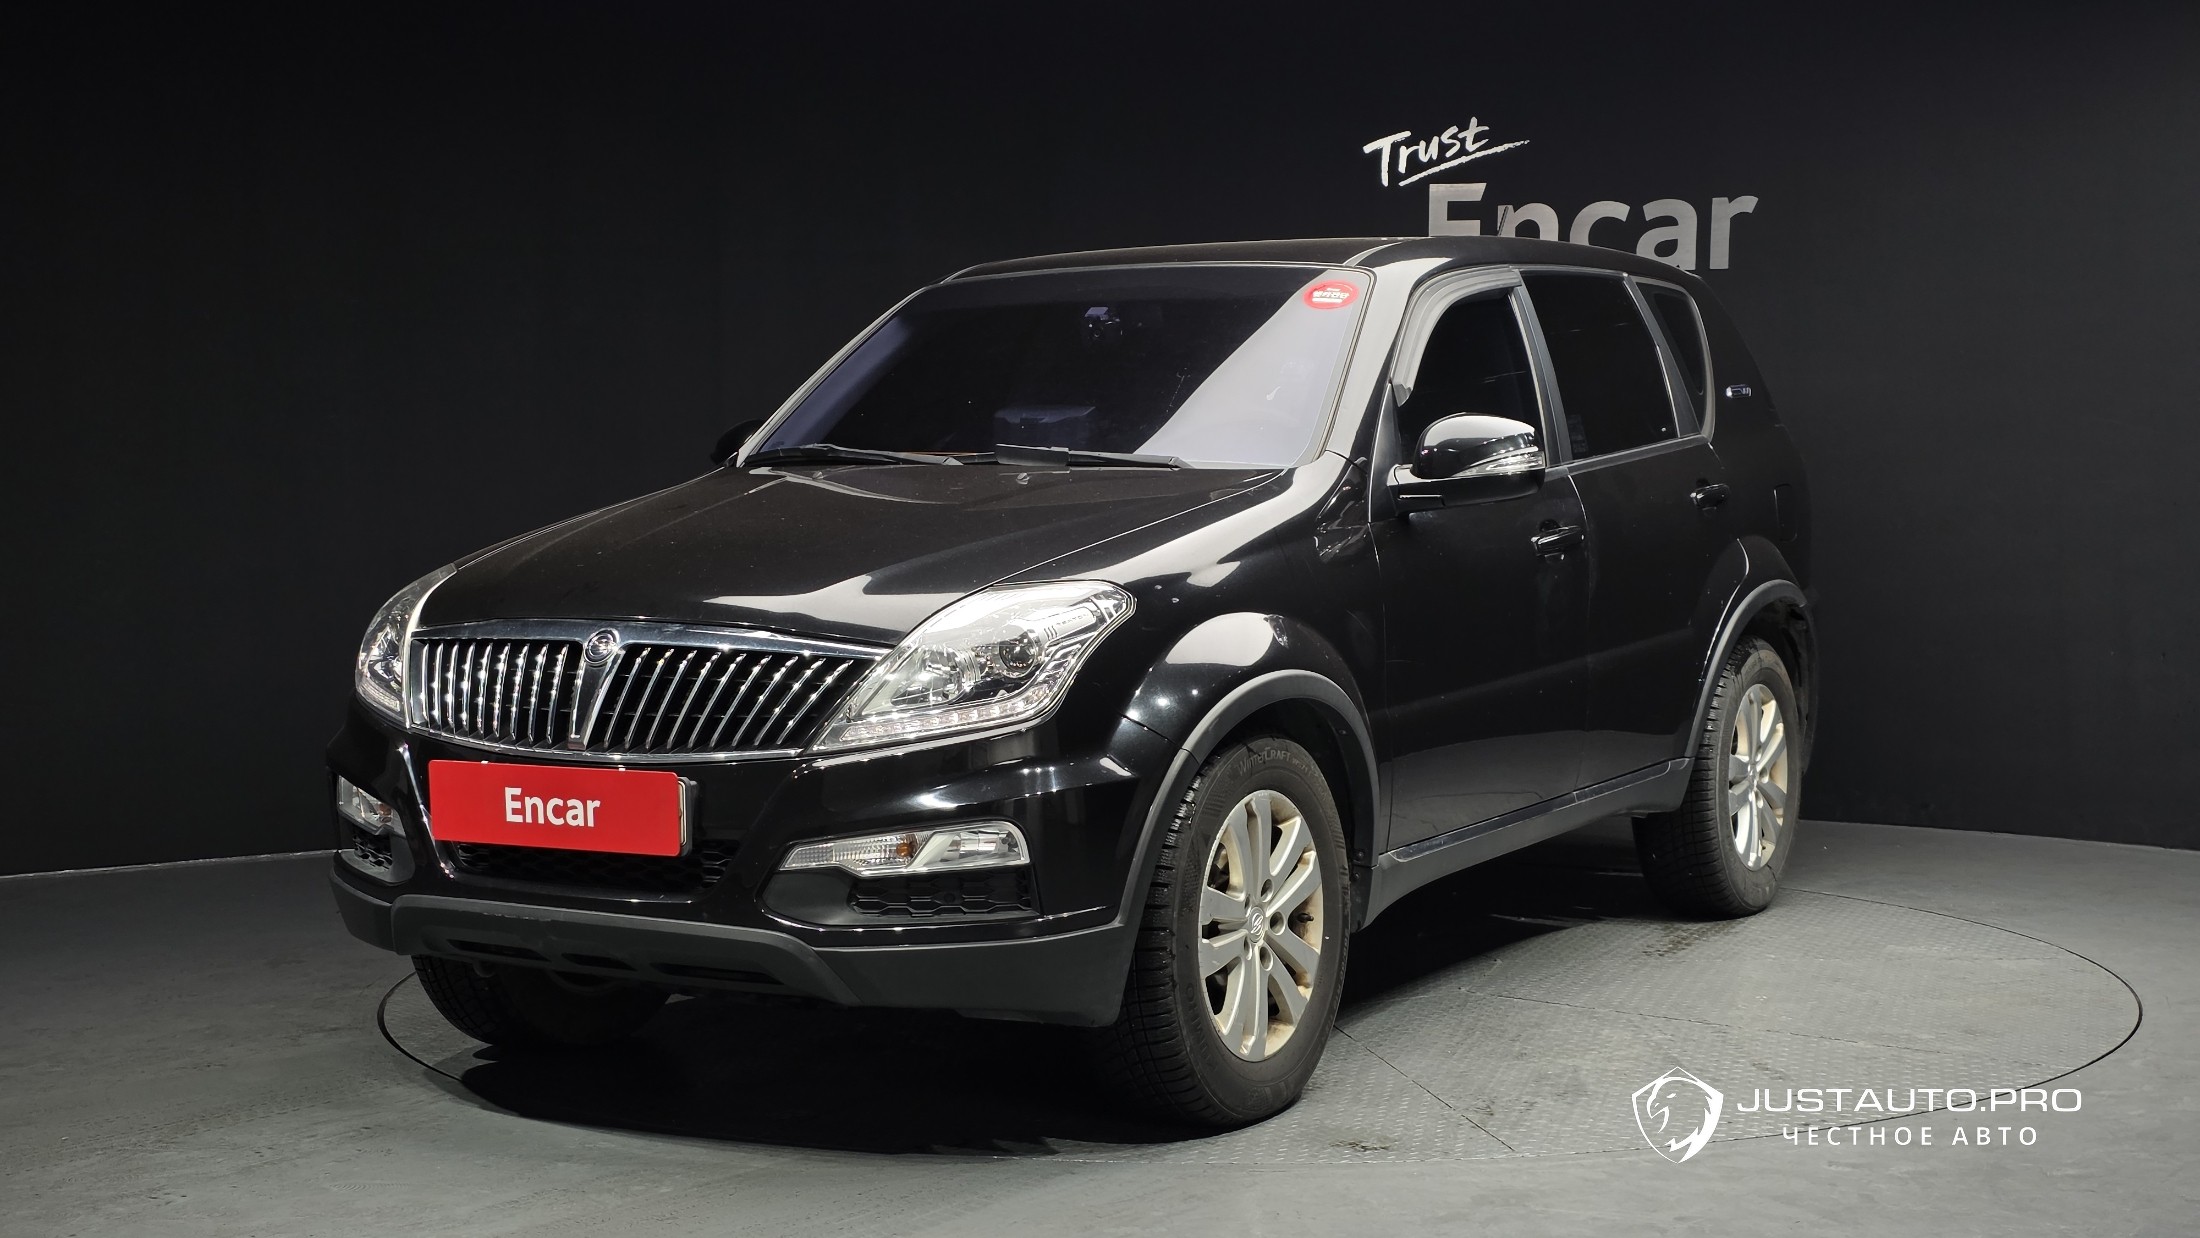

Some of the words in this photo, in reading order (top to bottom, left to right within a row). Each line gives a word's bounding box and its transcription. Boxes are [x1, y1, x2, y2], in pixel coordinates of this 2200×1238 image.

[1362, 116, 1491, 187] Trust
[1428, 182, 1759, 270] Encar
[504, 786, 601, 828] Encar
